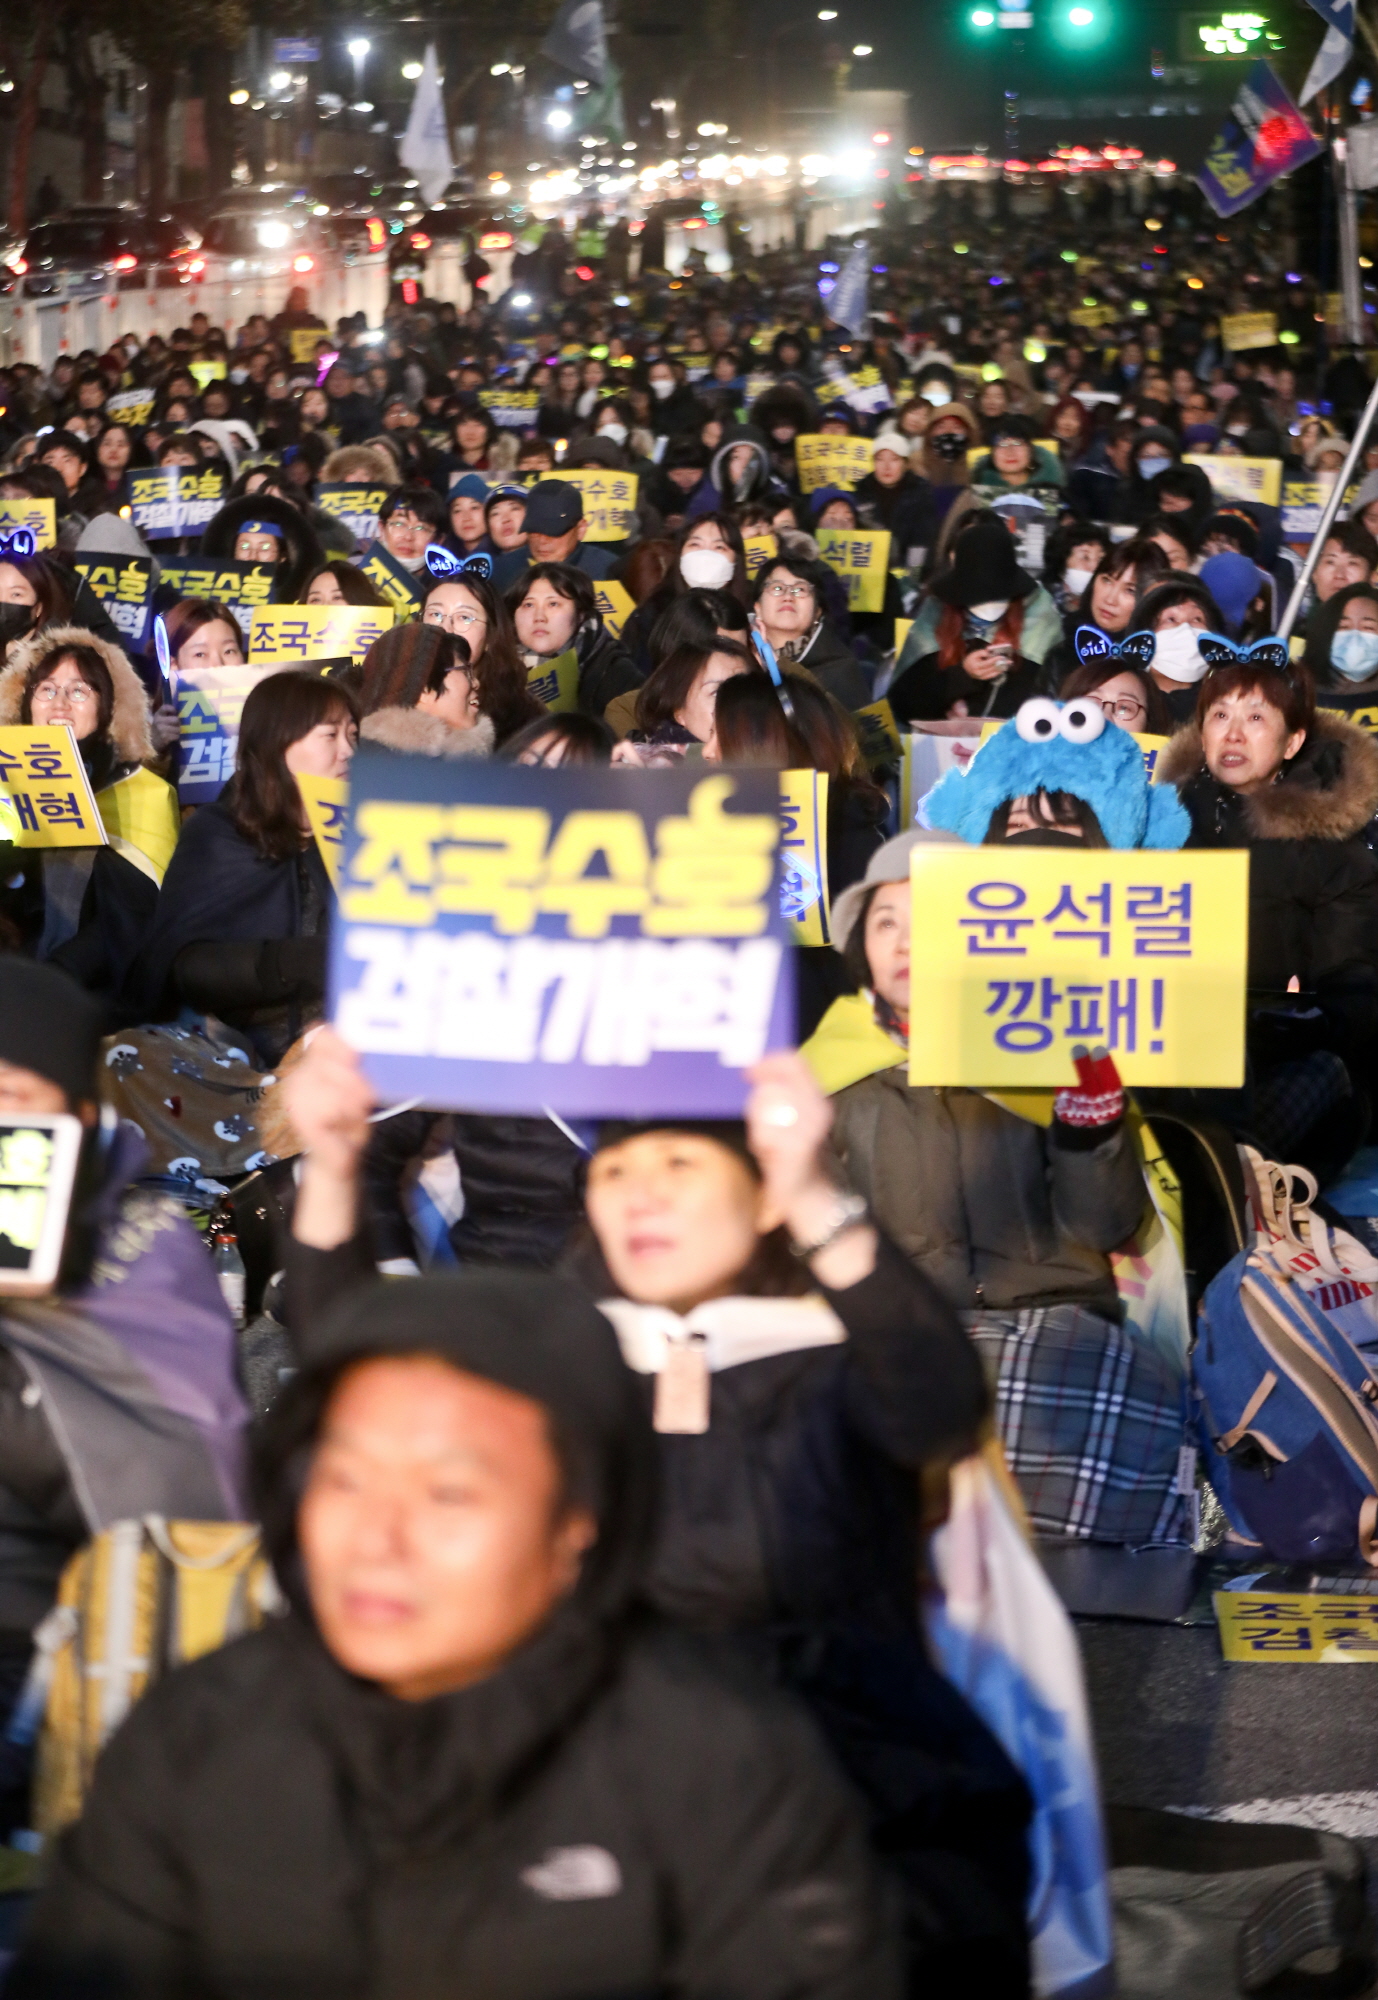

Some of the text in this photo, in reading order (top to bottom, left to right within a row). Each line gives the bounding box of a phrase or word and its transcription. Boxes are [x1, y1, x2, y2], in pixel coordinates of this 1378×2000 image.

[131, 468, 223, 504] 조국수호
[319, 490, 388, 516] 조국수
[251, 620, 384, 656] 조국수호
[337, 775, 782, 938] 조국수호
[959, 881, 1193, 957] 윤석렬
[984, 976, 1165, 1054] 깡패!
